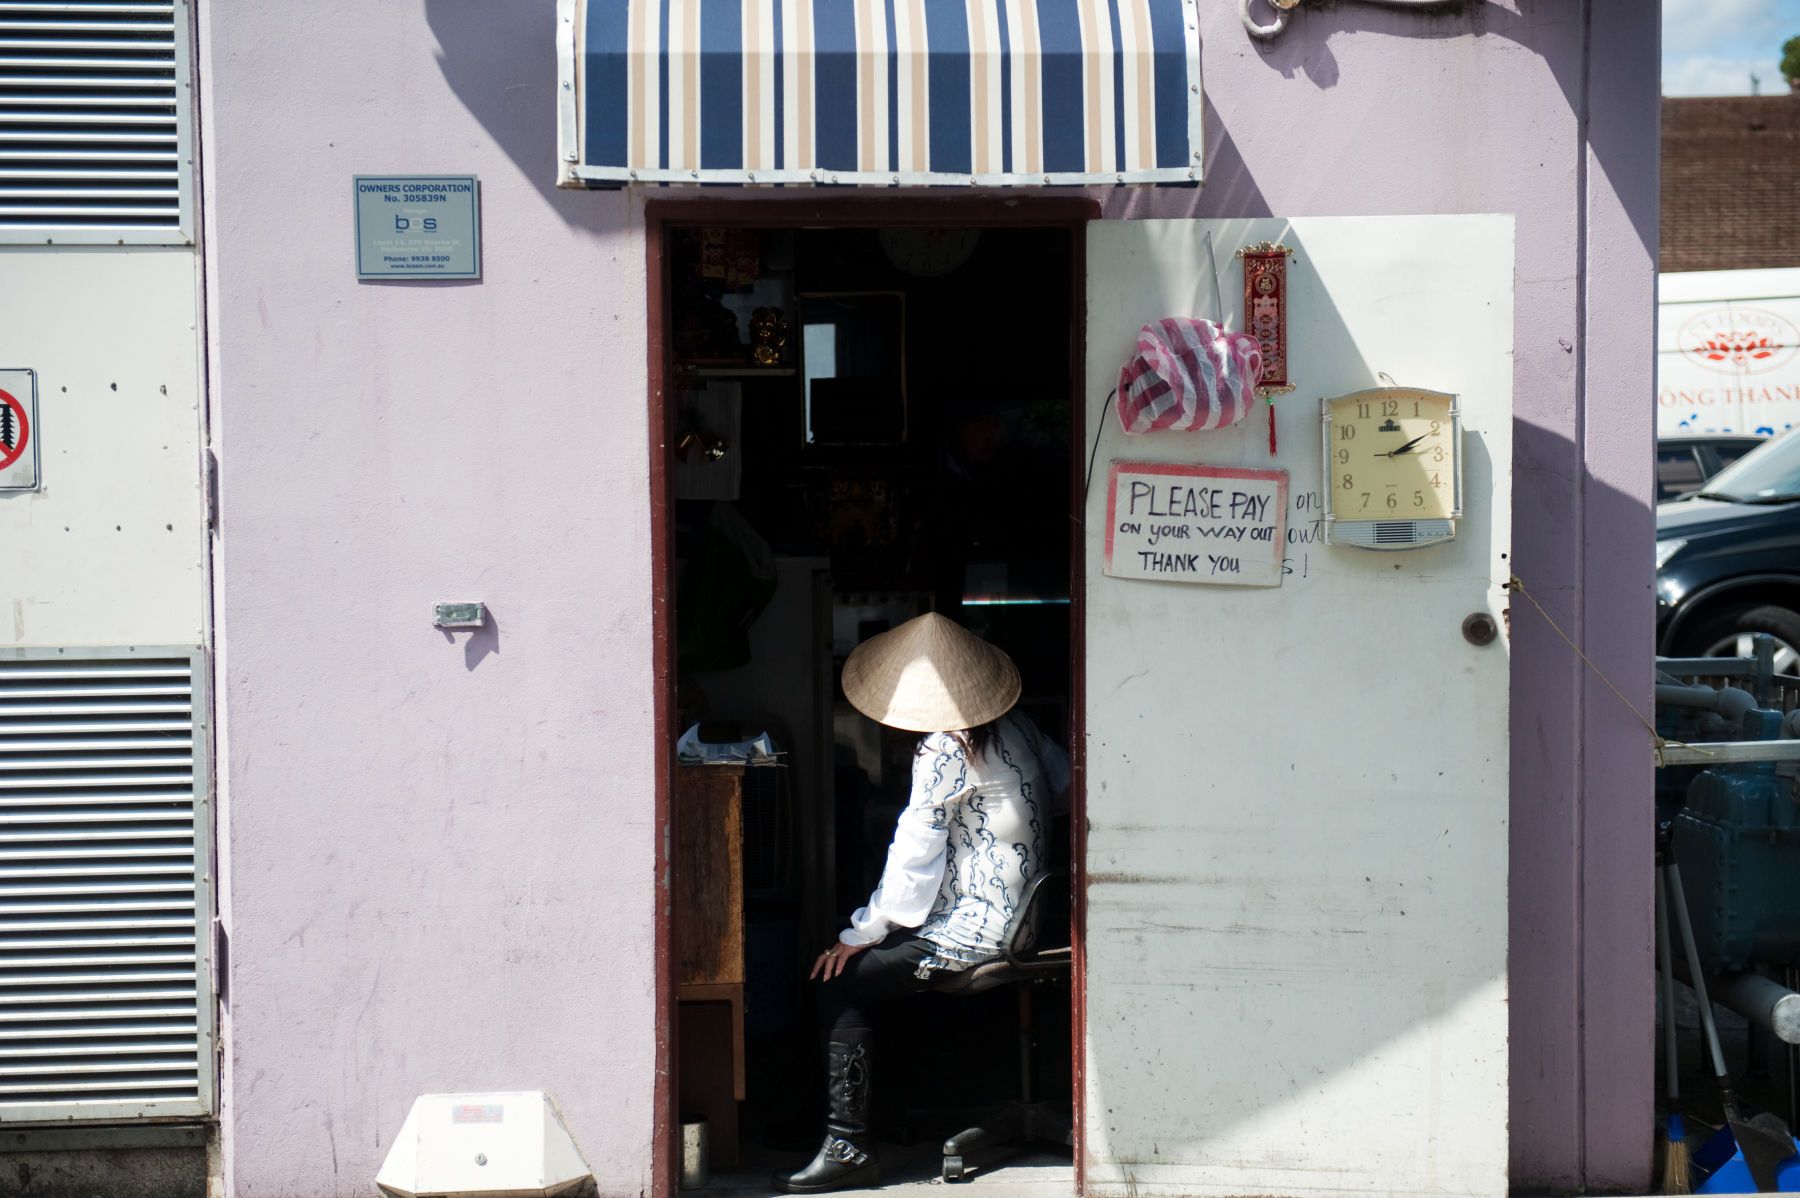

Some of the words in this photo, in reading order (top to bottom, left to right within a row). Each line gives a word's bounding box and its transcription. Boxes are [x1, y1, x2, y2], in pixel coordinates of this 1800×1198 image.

[360, 184, 400, 192] OWNERS
[402, 184, 471, 192] CORPORATION
[404, 194, 446, 202] 305839N
[1358, 404, 1370, 418] 11
[1381, 400, 1398, 416] 12
[1413, 402, 1419, 416] 1
[1339, 424, 1355, 440] 10
[1430, 420, 1440, 436] 2
[1338, 449, 1349, 464] 9
[1433, 446, 1443, 462] 3
[1342, 474, 1353, 489] 8
[1430, 472, 1441, 488] 4
[1129, 482, 1223, 519] PLEASE
[1229, 492, 1271, 522] PAY
[1296, 491, 1321, 512] on
[1360, 492, 1371, 508] 7
[1386, 493, 1397, 509] 6
[1413, 491, 1424, 506] 5
[1120, 523, 1141, 534] ON
[1197, 526, 1247, 542] WAY
[1251, 526, 1277, 542] OUT
[1138, 551, 1199, 573] THANK
[1208, 554, 1240, 575] YOU
